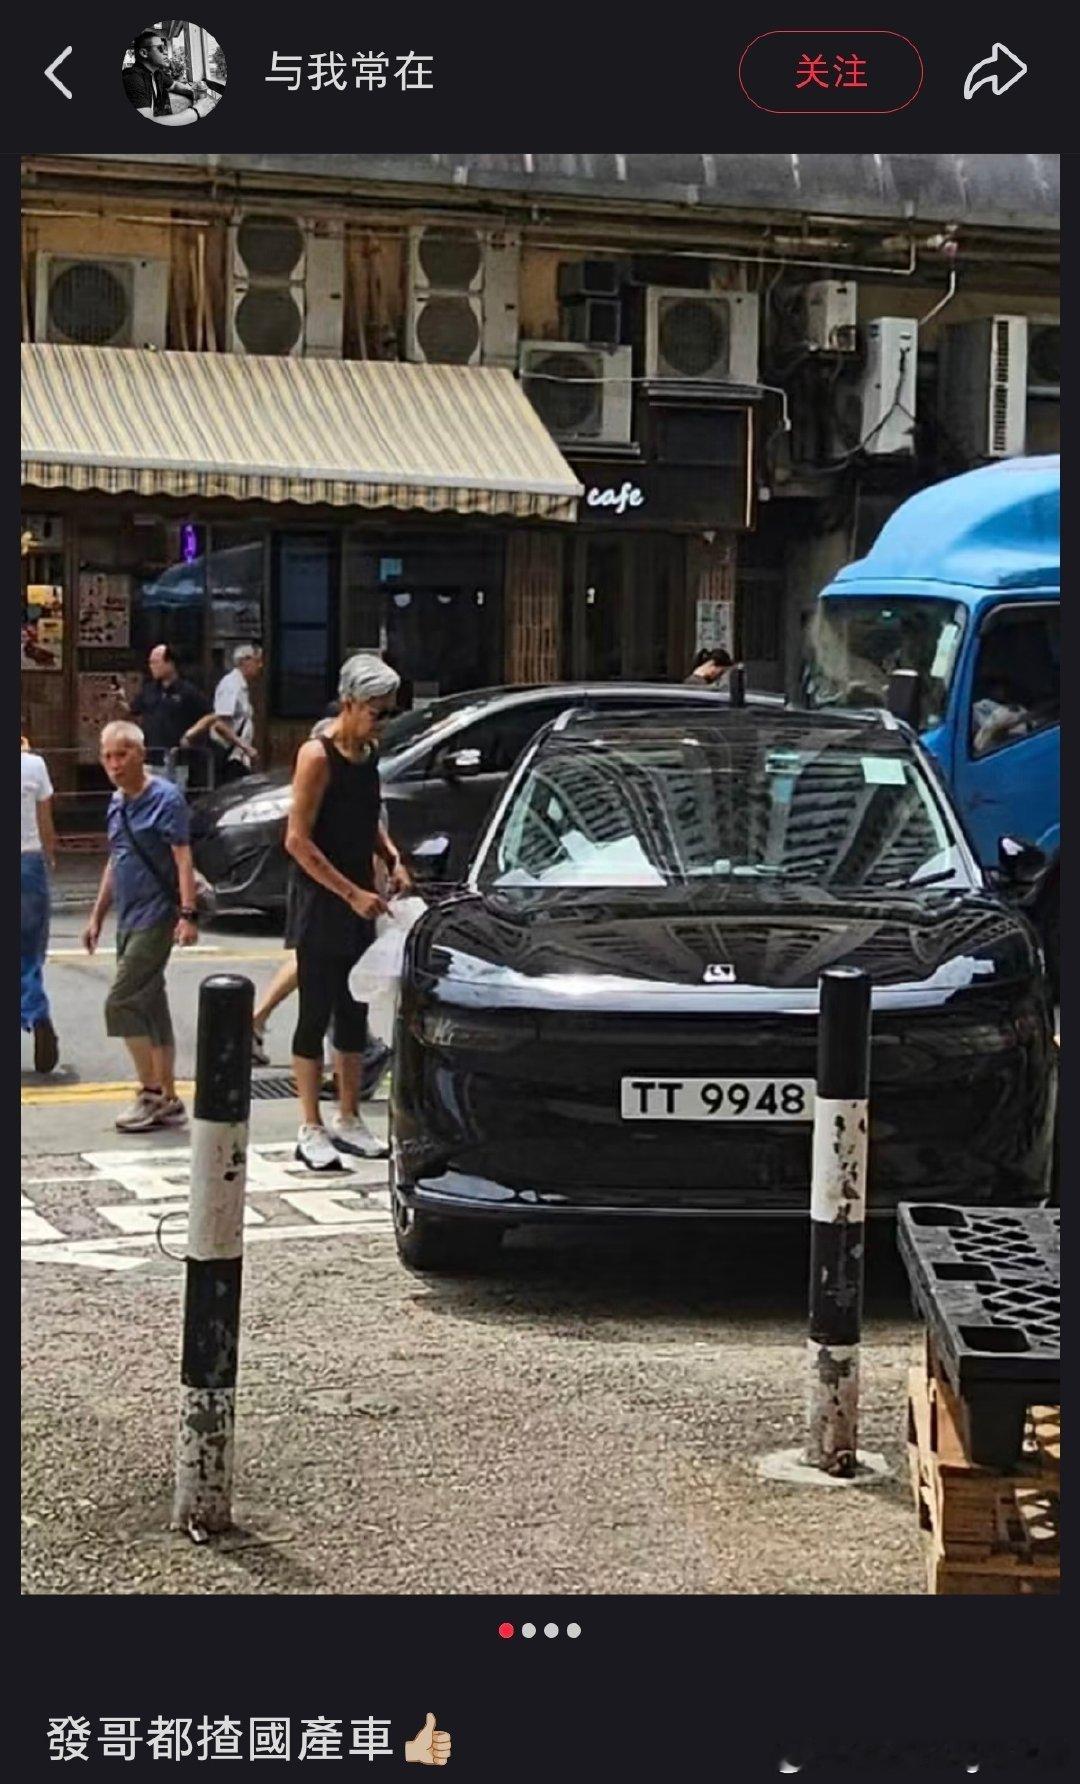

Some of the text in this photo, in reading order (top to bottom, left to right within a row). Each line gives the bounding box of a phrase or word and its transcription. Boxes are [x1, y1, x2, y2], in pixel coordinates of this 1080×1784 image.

[587, 482, 644, 513] cafe
[631, 1082, 805, 1115] TT 9948
